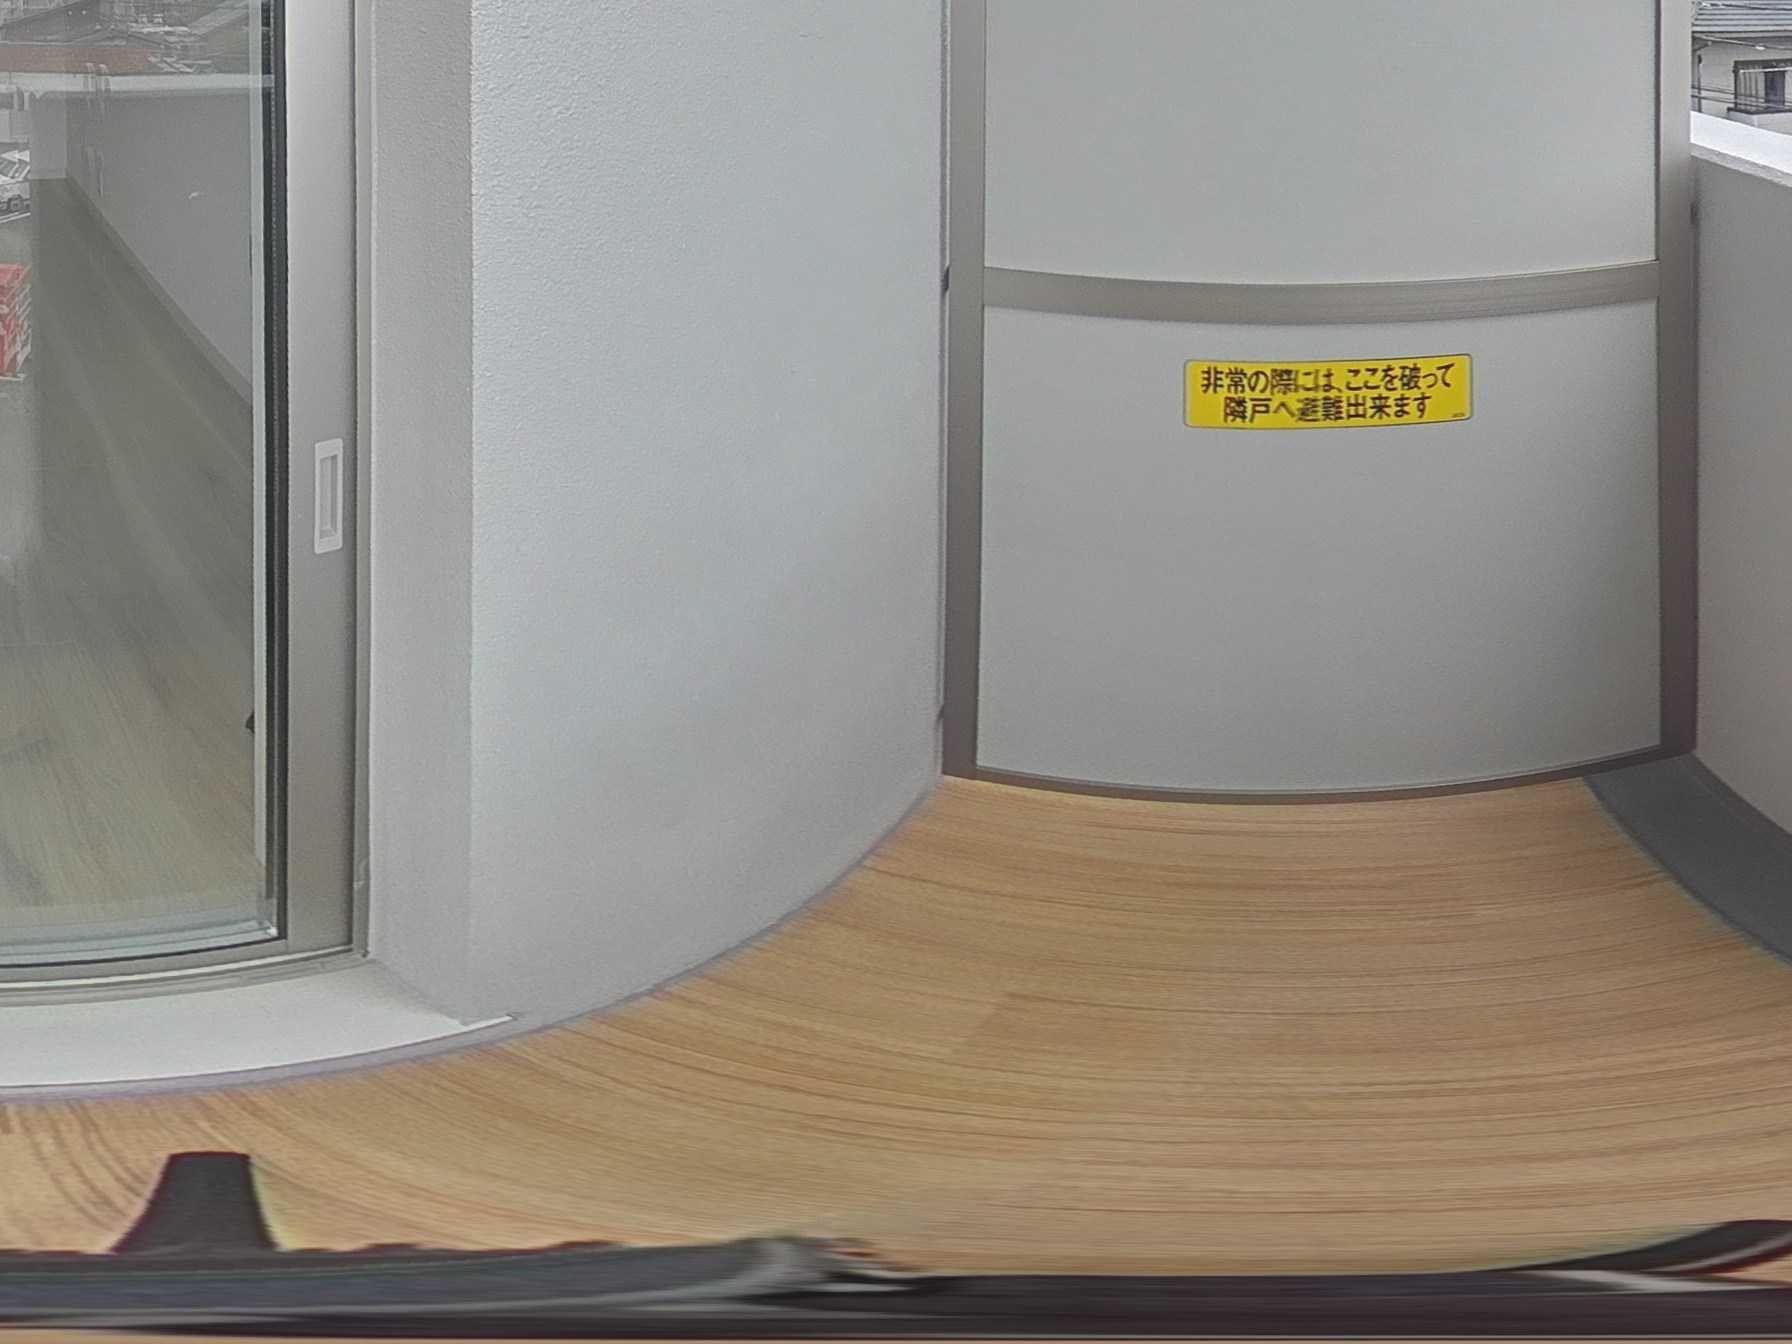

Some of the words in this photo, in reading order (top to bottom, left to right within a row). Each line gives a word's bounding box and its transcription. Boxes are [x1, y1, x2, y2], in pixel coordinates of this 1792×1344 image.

[1223, 392, 1432, 424] 隣戸へ避難出来ます
